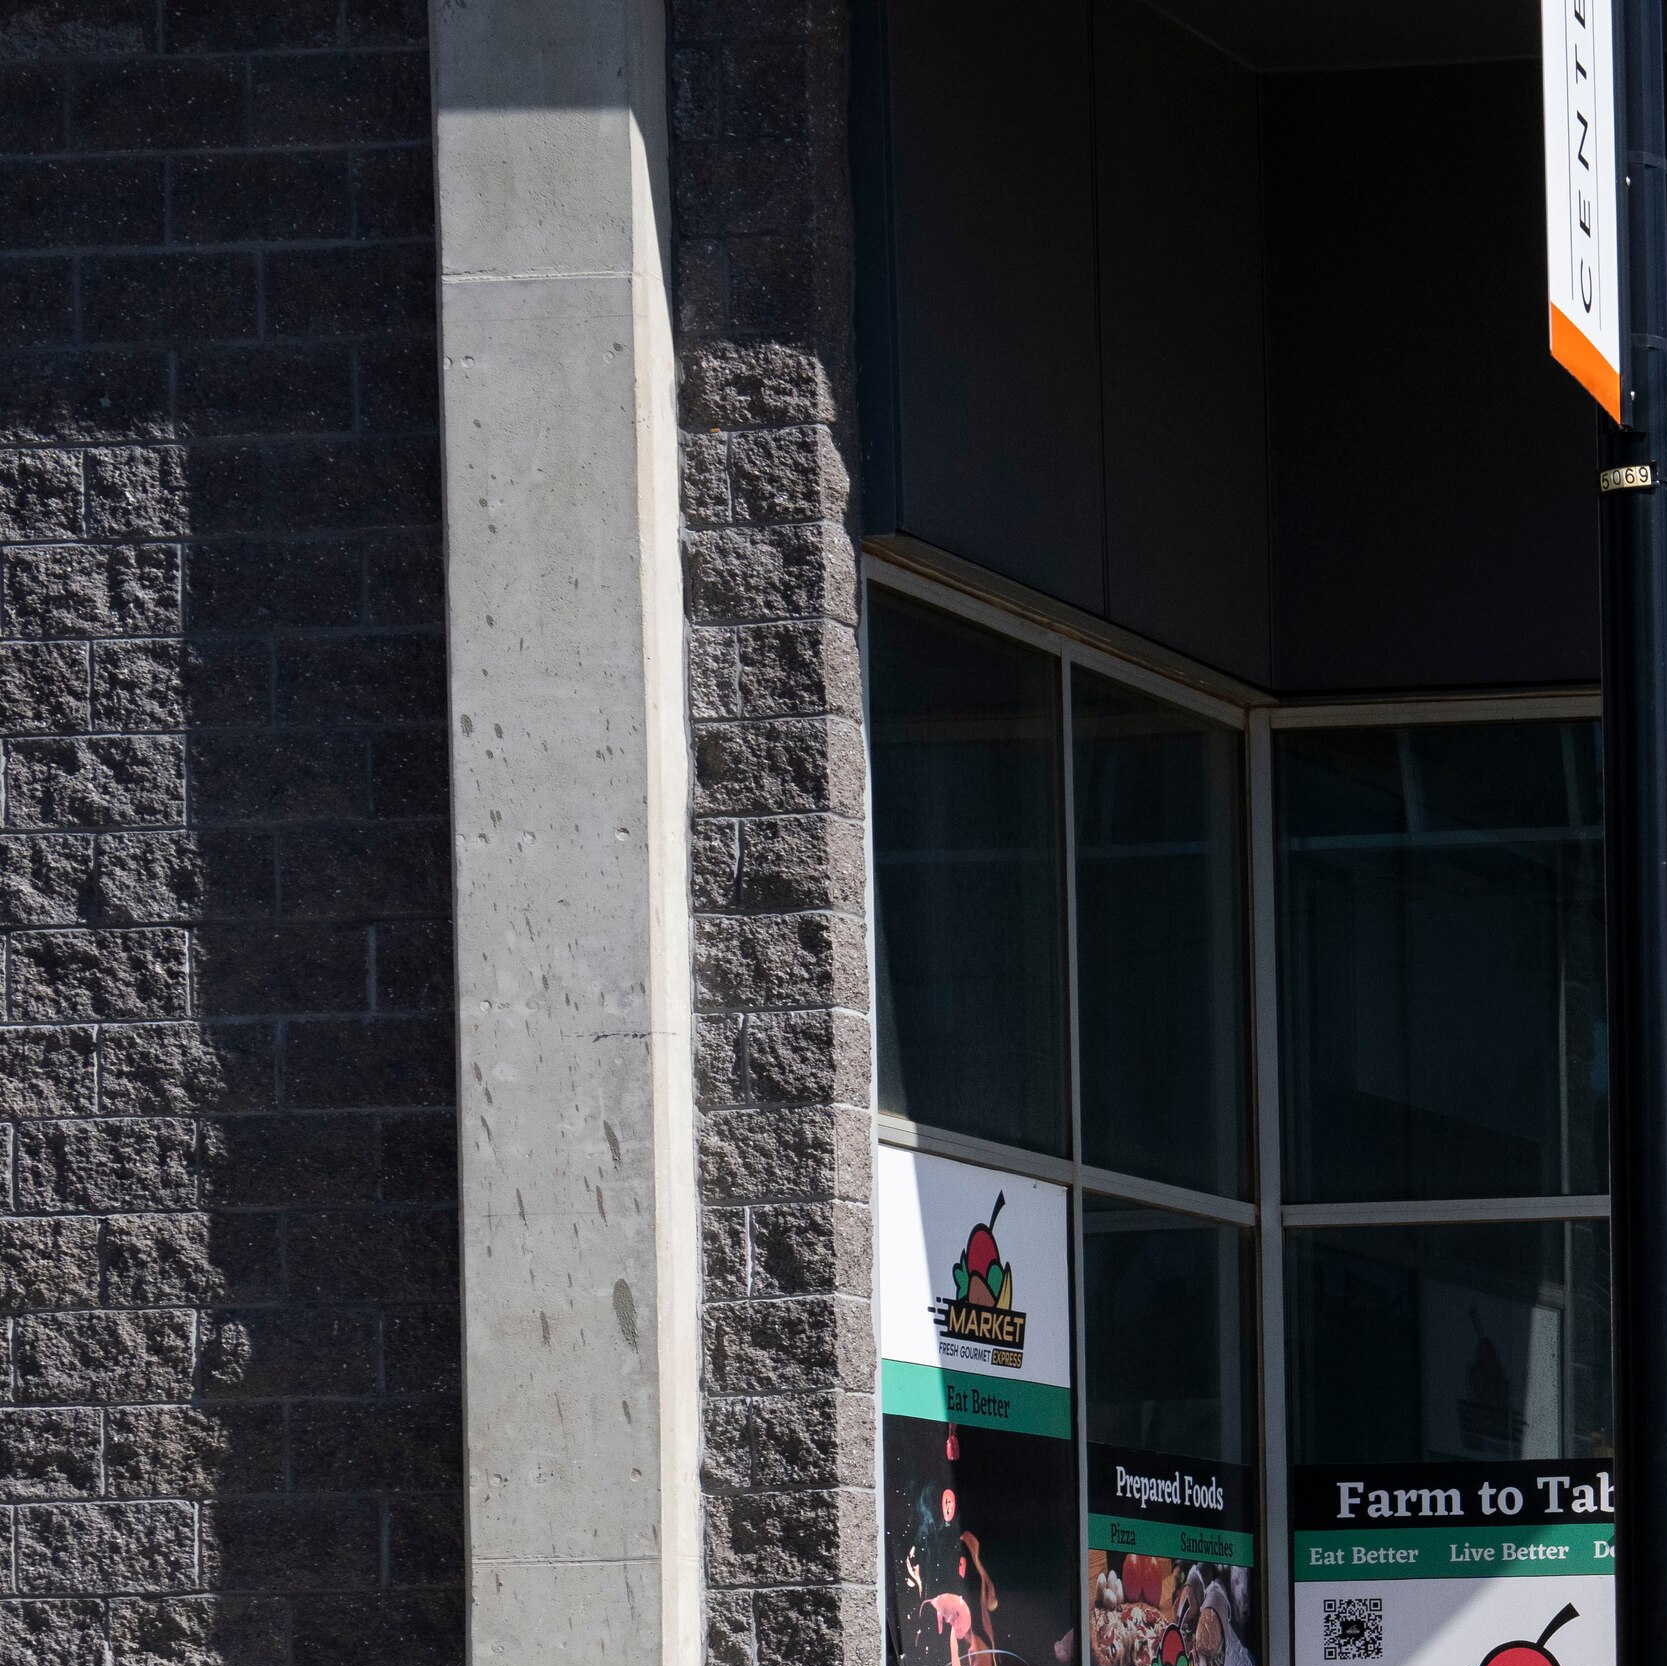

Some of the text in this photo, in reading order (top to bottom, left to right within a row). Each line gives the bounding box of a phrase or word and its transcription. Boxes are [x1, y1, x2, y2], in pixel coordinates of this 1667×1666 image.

[1602, 466, 1649, 490] 5069
[949, 1306, 1024, 1343] MARKET
[939, 1342, 1023, 1367] FRESH GOURMET EXPRESS
[947, 1385, 1011, 1419] Eat Better
[1116, 1466, 1224, 1511] Prepared Foods
[1336, 1481, 1464, 1518] Farm
[1478, 1481, 1523, 1515] to
[1110, 1523, 1233, 1558] Pizza Sandwiches
[1309, 1547, 1344, 1565] Eat
[1352, 1546, 1418, 1565] Better
[1449, 1542, 1495, 1562] Live
[1502, 1541, 1569, 1561] Better
